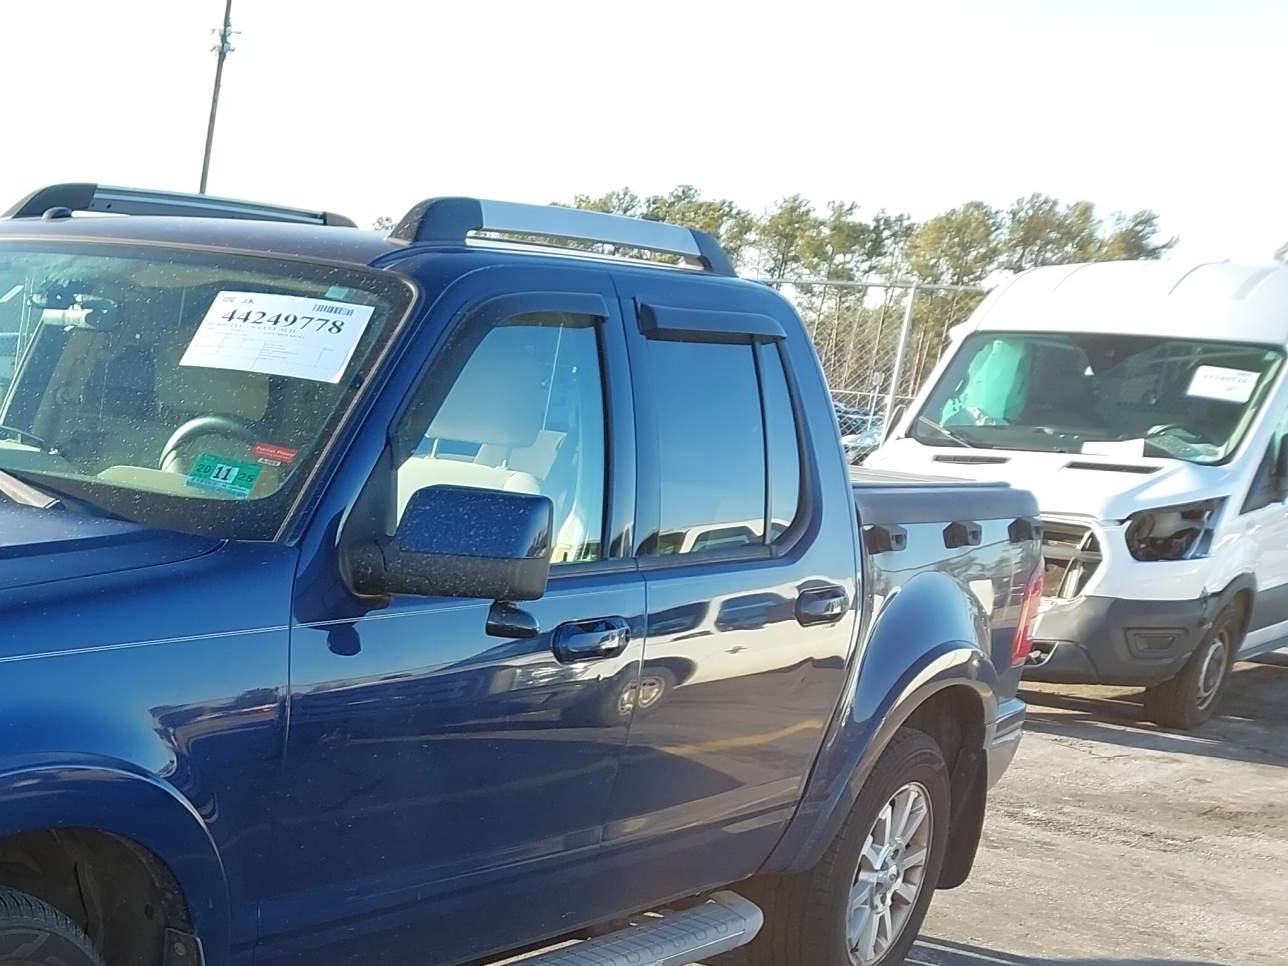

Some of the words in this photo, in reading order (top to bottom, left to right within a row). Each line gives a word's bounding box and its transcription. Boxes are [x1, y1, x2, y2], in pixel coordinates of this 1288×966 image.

[221, 308, 345, 335] 44249778
[196, 463, 212, 474] 20
[213, 465, 233, 481] 11
